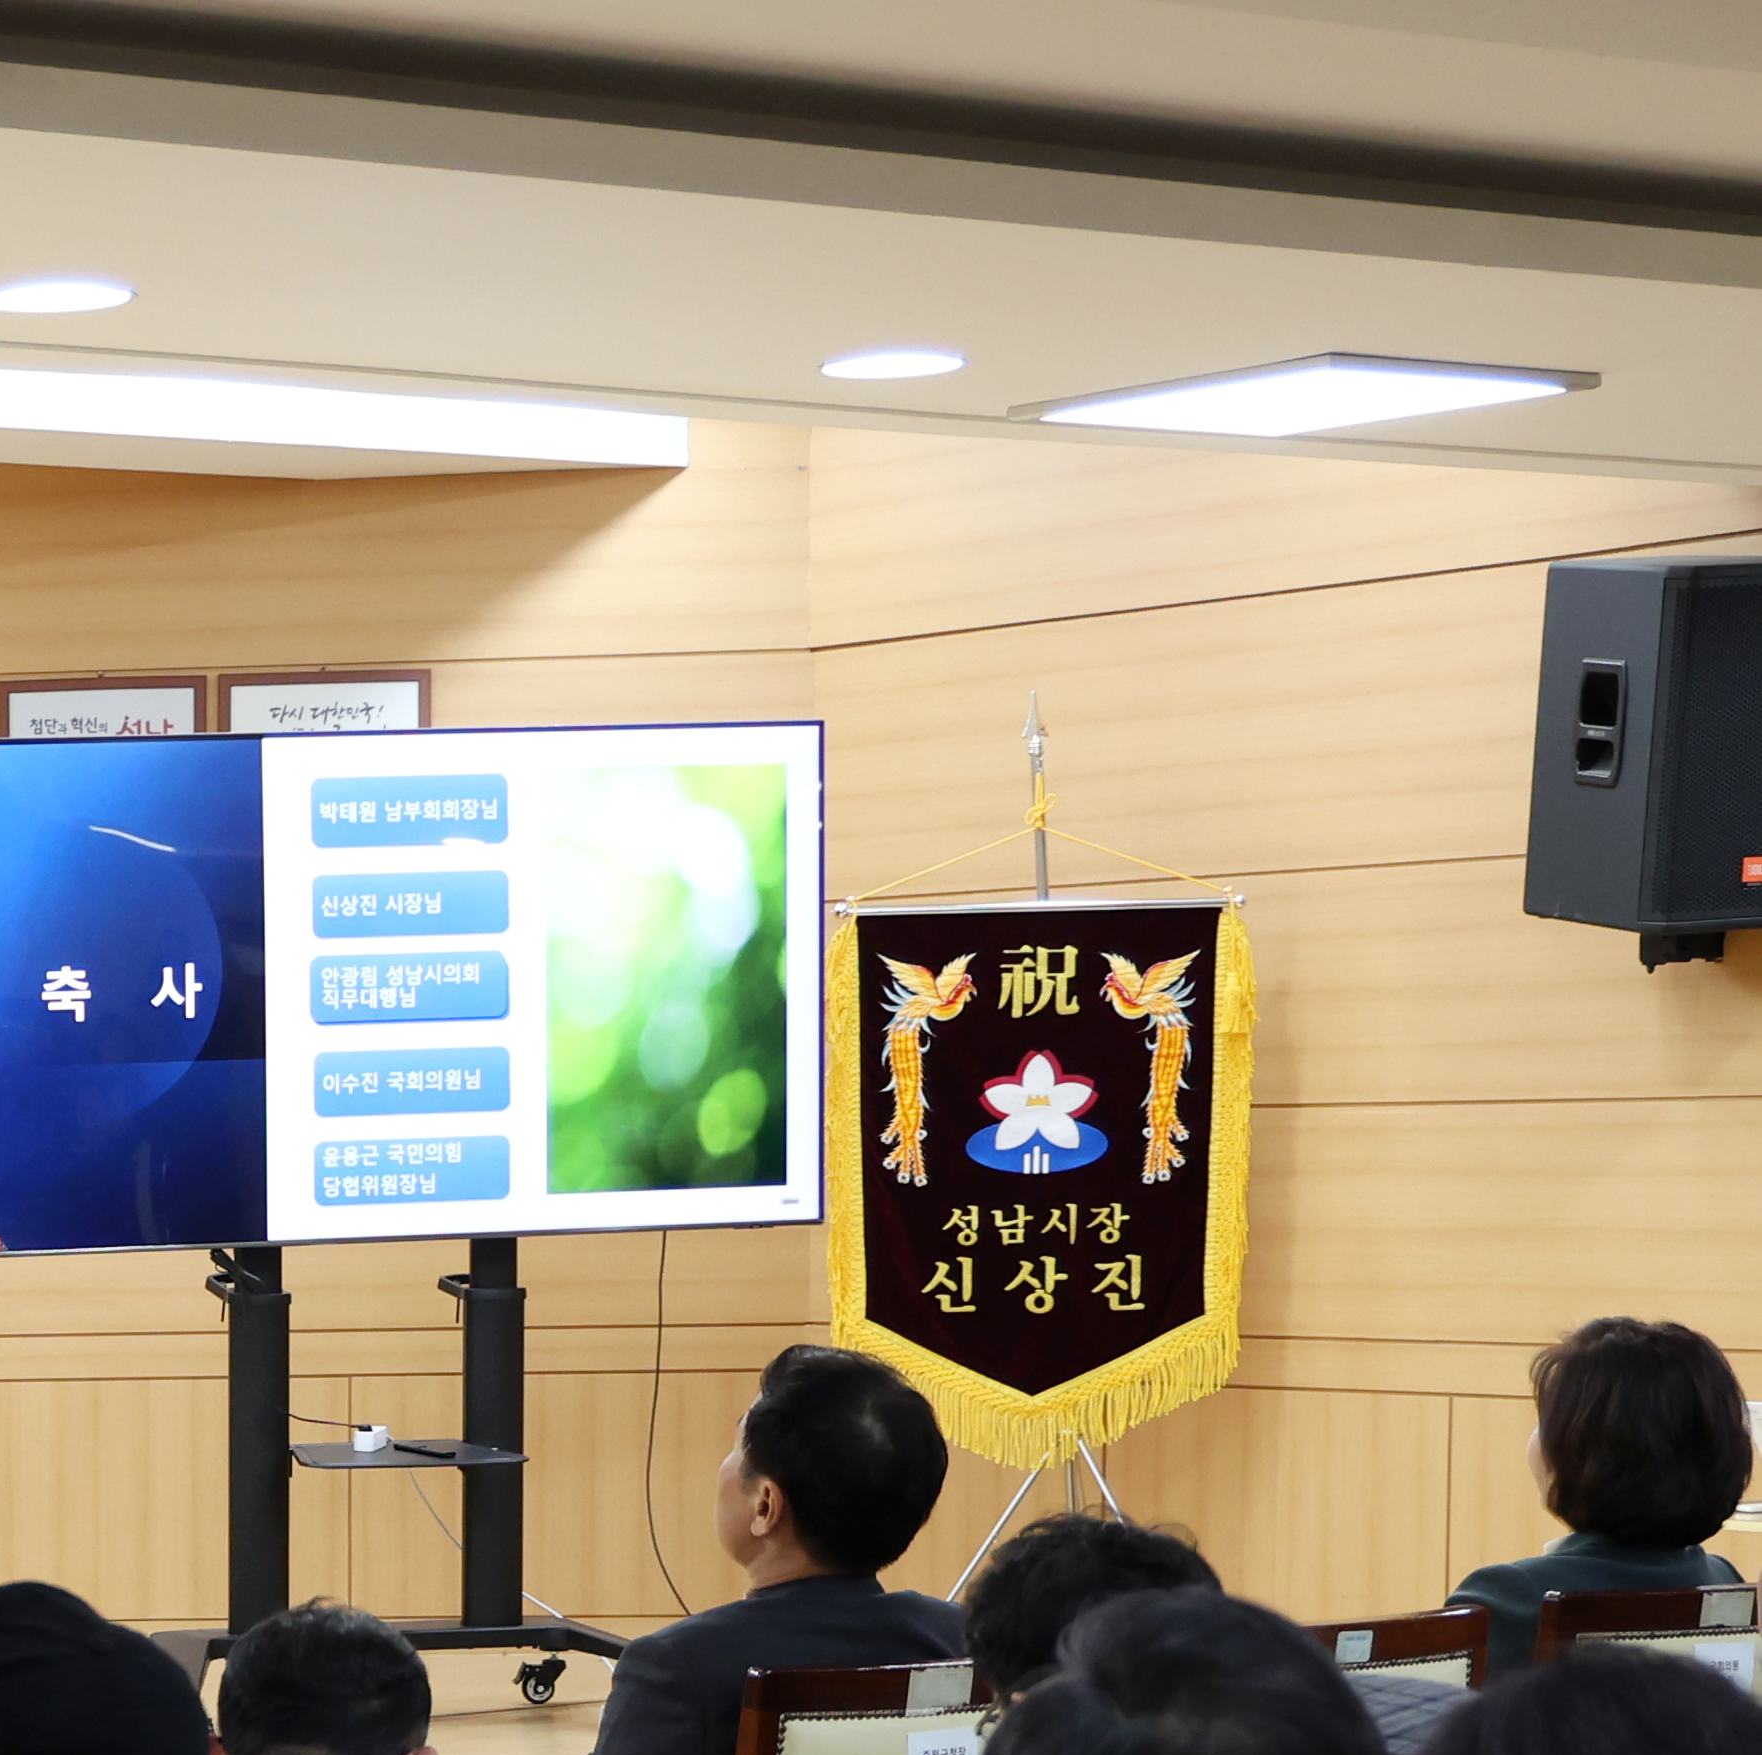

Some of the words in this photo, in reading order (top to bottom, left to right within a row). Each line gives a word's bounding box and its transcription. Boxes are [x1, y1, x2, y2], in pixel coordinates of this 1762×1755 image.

[270, 705, 303, 723] 다시
[310, 701, 384, 724] 대한민국!
[30, 719, 67, 735] 첨단과
[71, 717, 107, 733] 혁신의
[320, 801, 376, 823] 박태원
[385, 798, 497, 822] 남부회회장님
[321, 894, 377, 917] 신상진
[385, 892, 441, 915] 시장님
[322, 966, 377, 987] 안광림
[386, 962, 479, 985] 성남시의회
[999, 945, 1079, 1018] 祝
[322, 986, 416, 1010] 직무대행님
[323, 1072, 379, 1094] 이수진
[386, 1068, 481, 1092] 국회의원님
[322, 1146, 380, 1167] 윤용근
[386, 1141, 462, 1165] 국민의힘
[322, 1173, 437, 1198] 당협위원장님
[943, 1203, 1130, 1245] 성남시장
